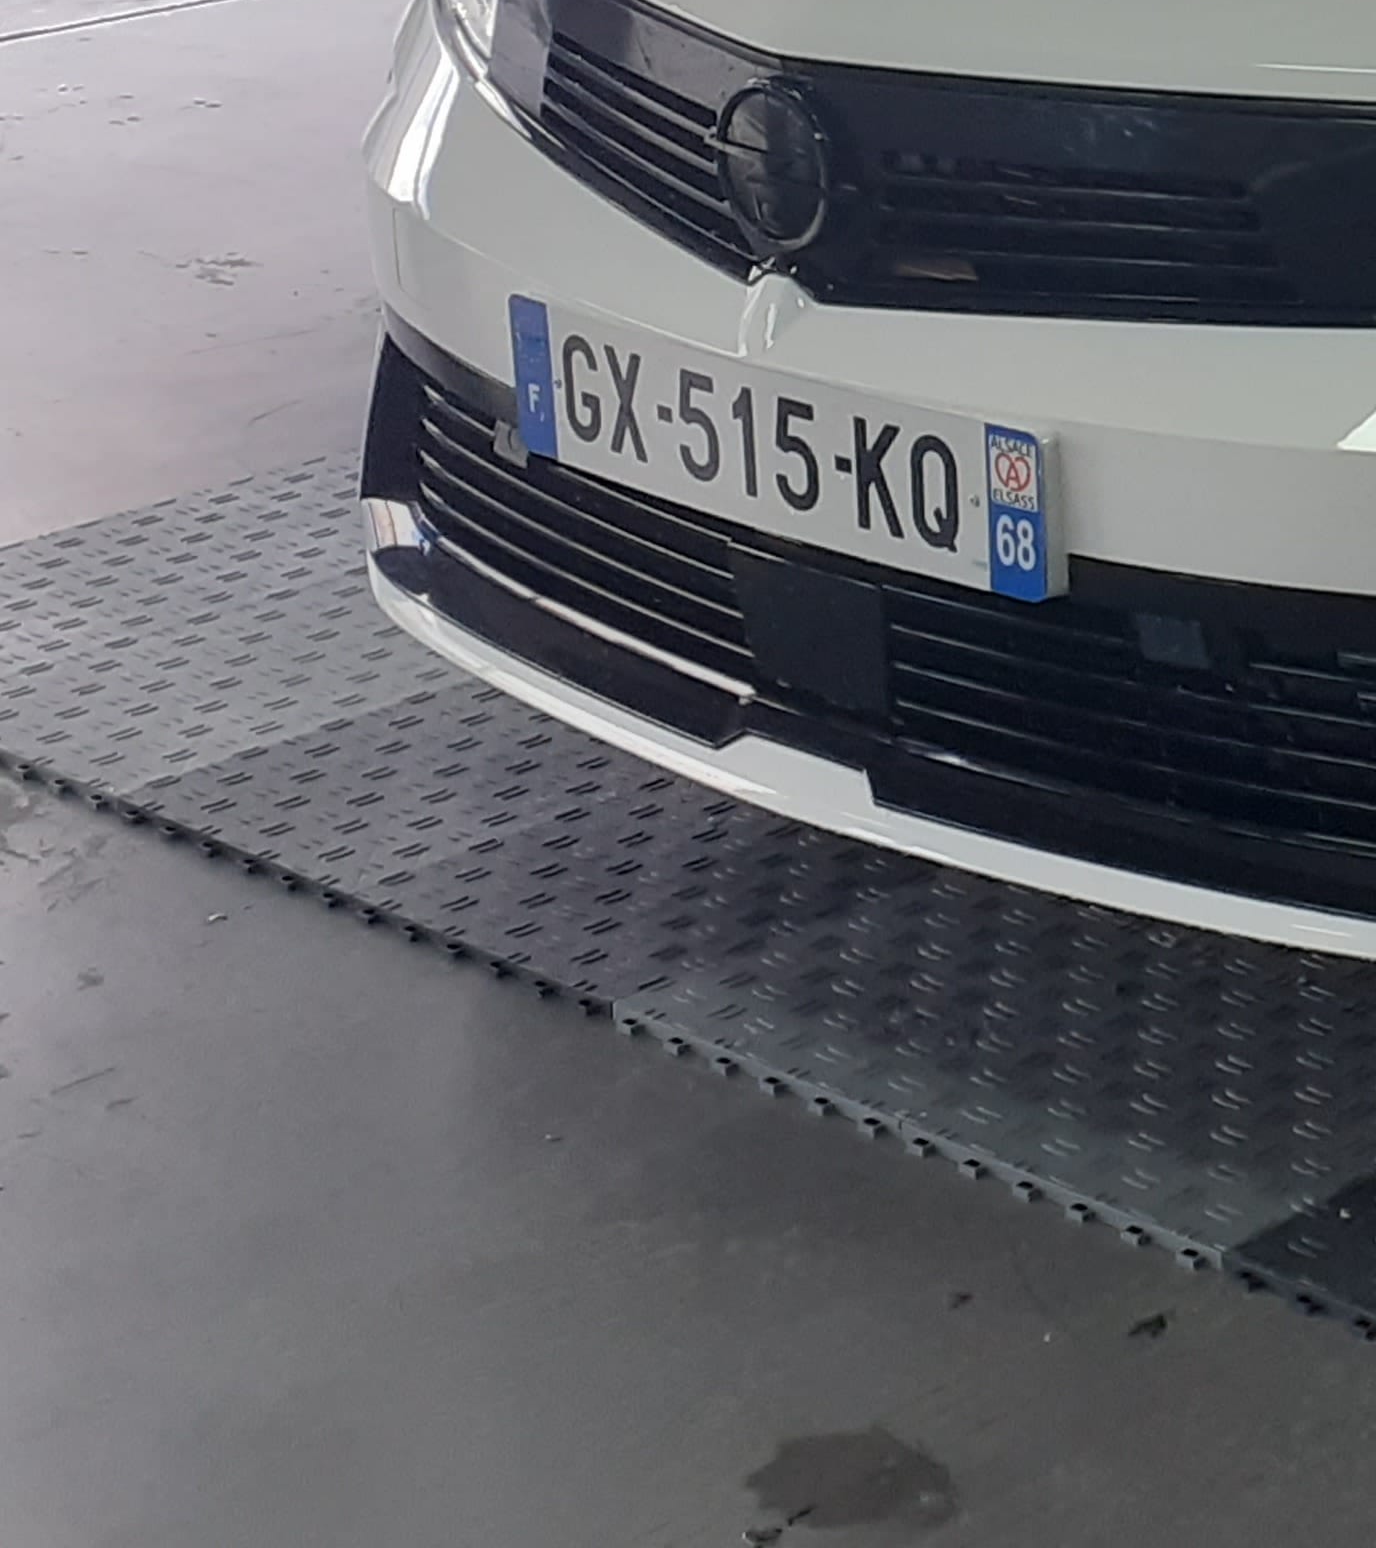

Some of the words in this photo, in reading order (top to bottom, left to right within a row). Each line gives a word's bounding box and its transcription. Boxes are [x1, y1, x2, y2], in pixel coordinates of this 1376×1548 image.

[527, 383, 541, 414] F
[562, 334, 959, 553] GX-515-KQ
[991, 435, 1032, 458] ALSACE
[993, 487, 1035, 511] ELSASS
[996, 513, 1037, 572] 68
